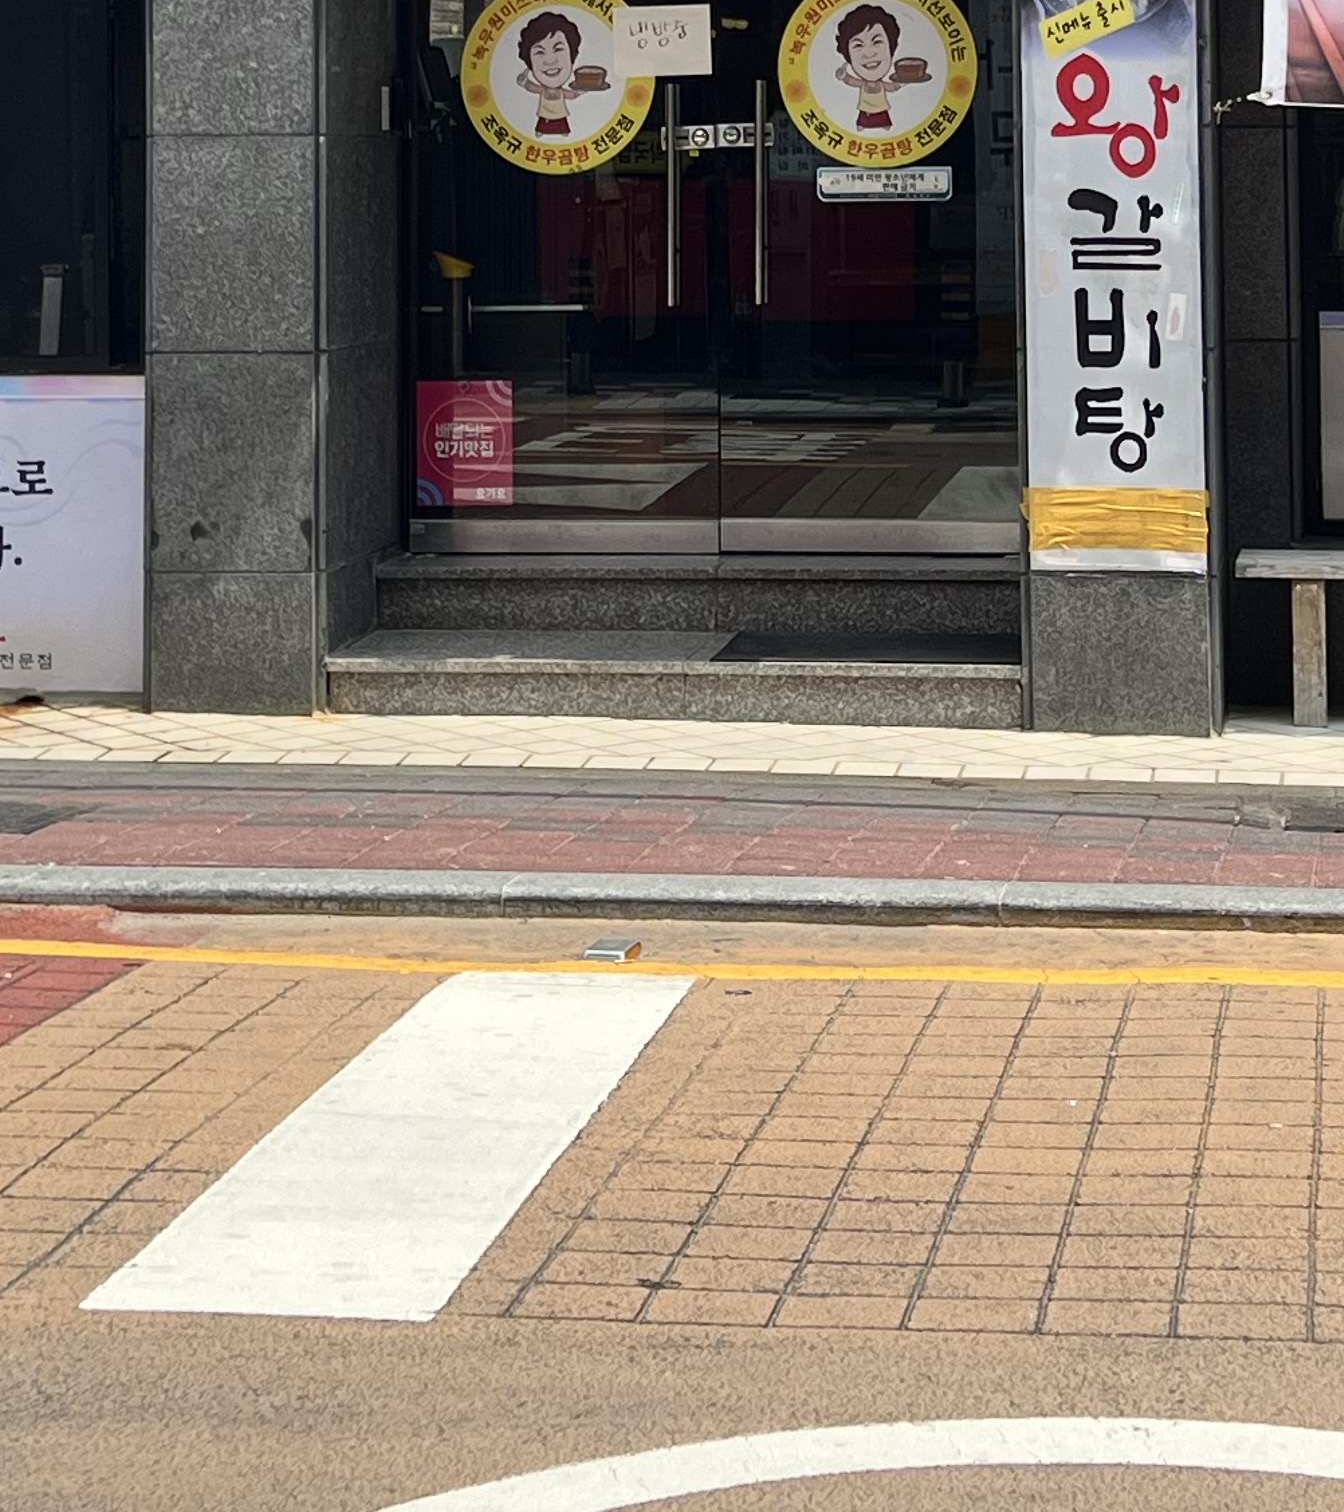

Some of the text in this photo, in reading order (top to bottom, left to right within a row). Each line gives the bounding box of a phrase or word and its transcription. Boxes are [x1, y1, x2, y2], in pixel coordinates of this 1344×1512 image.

[1046, 0, 1126, 45] 신메뉴 출시
[480, 113, 523, 155] 조옥규
[525, 144, 590, 167] 한우곰탕
[590, 113, 635, 156] 전문점
[800, 108, 845, 150] 조옥규
[846, 137, 913, 160] 한우곰탕
[914, 105, 959, 148] 전문점
[434, 440, 494, 458] 인기맛집
[0, 652, 53, 671] 전문점
